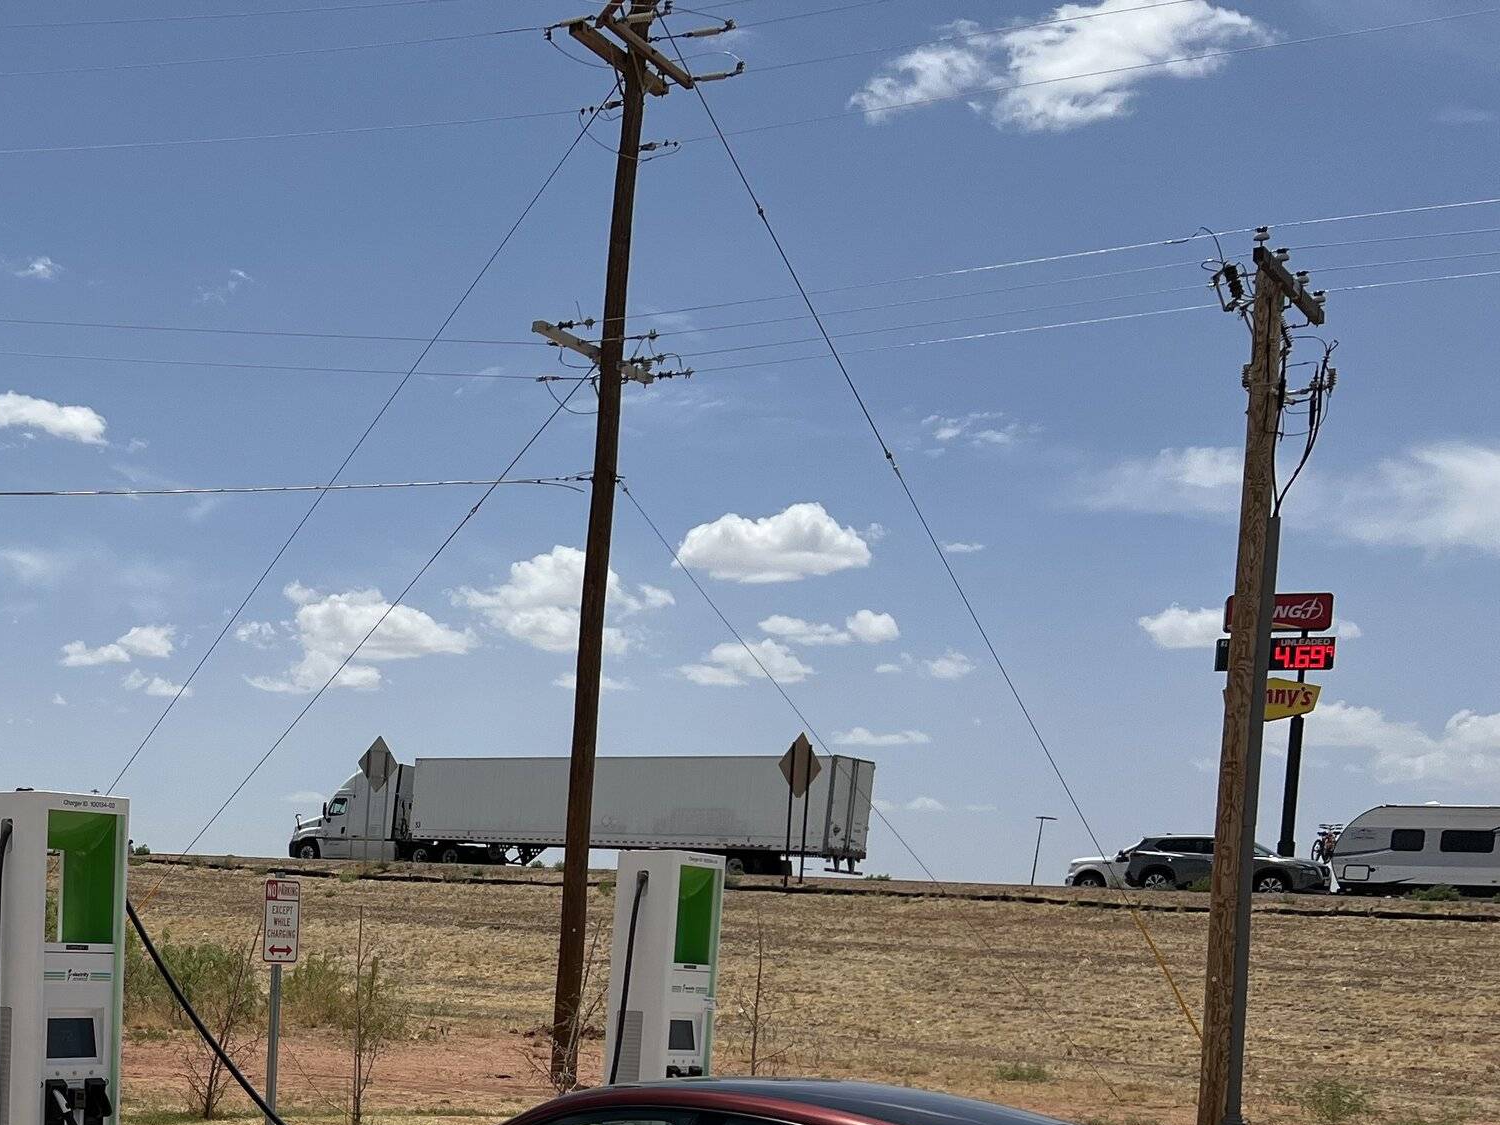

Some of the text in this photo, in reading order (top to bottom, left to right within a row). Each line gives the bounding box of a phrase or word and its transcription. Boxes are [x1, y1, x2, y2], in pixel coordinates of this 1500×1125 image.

[1281, 638, 1331, 646] UNLEADED
[267, 883, 276, 898] NO
[271, 905, 293, 915] EXCEPT
[273, 917, 291, 927] WHILE
[267, 928, 295, 939] CHARGING
